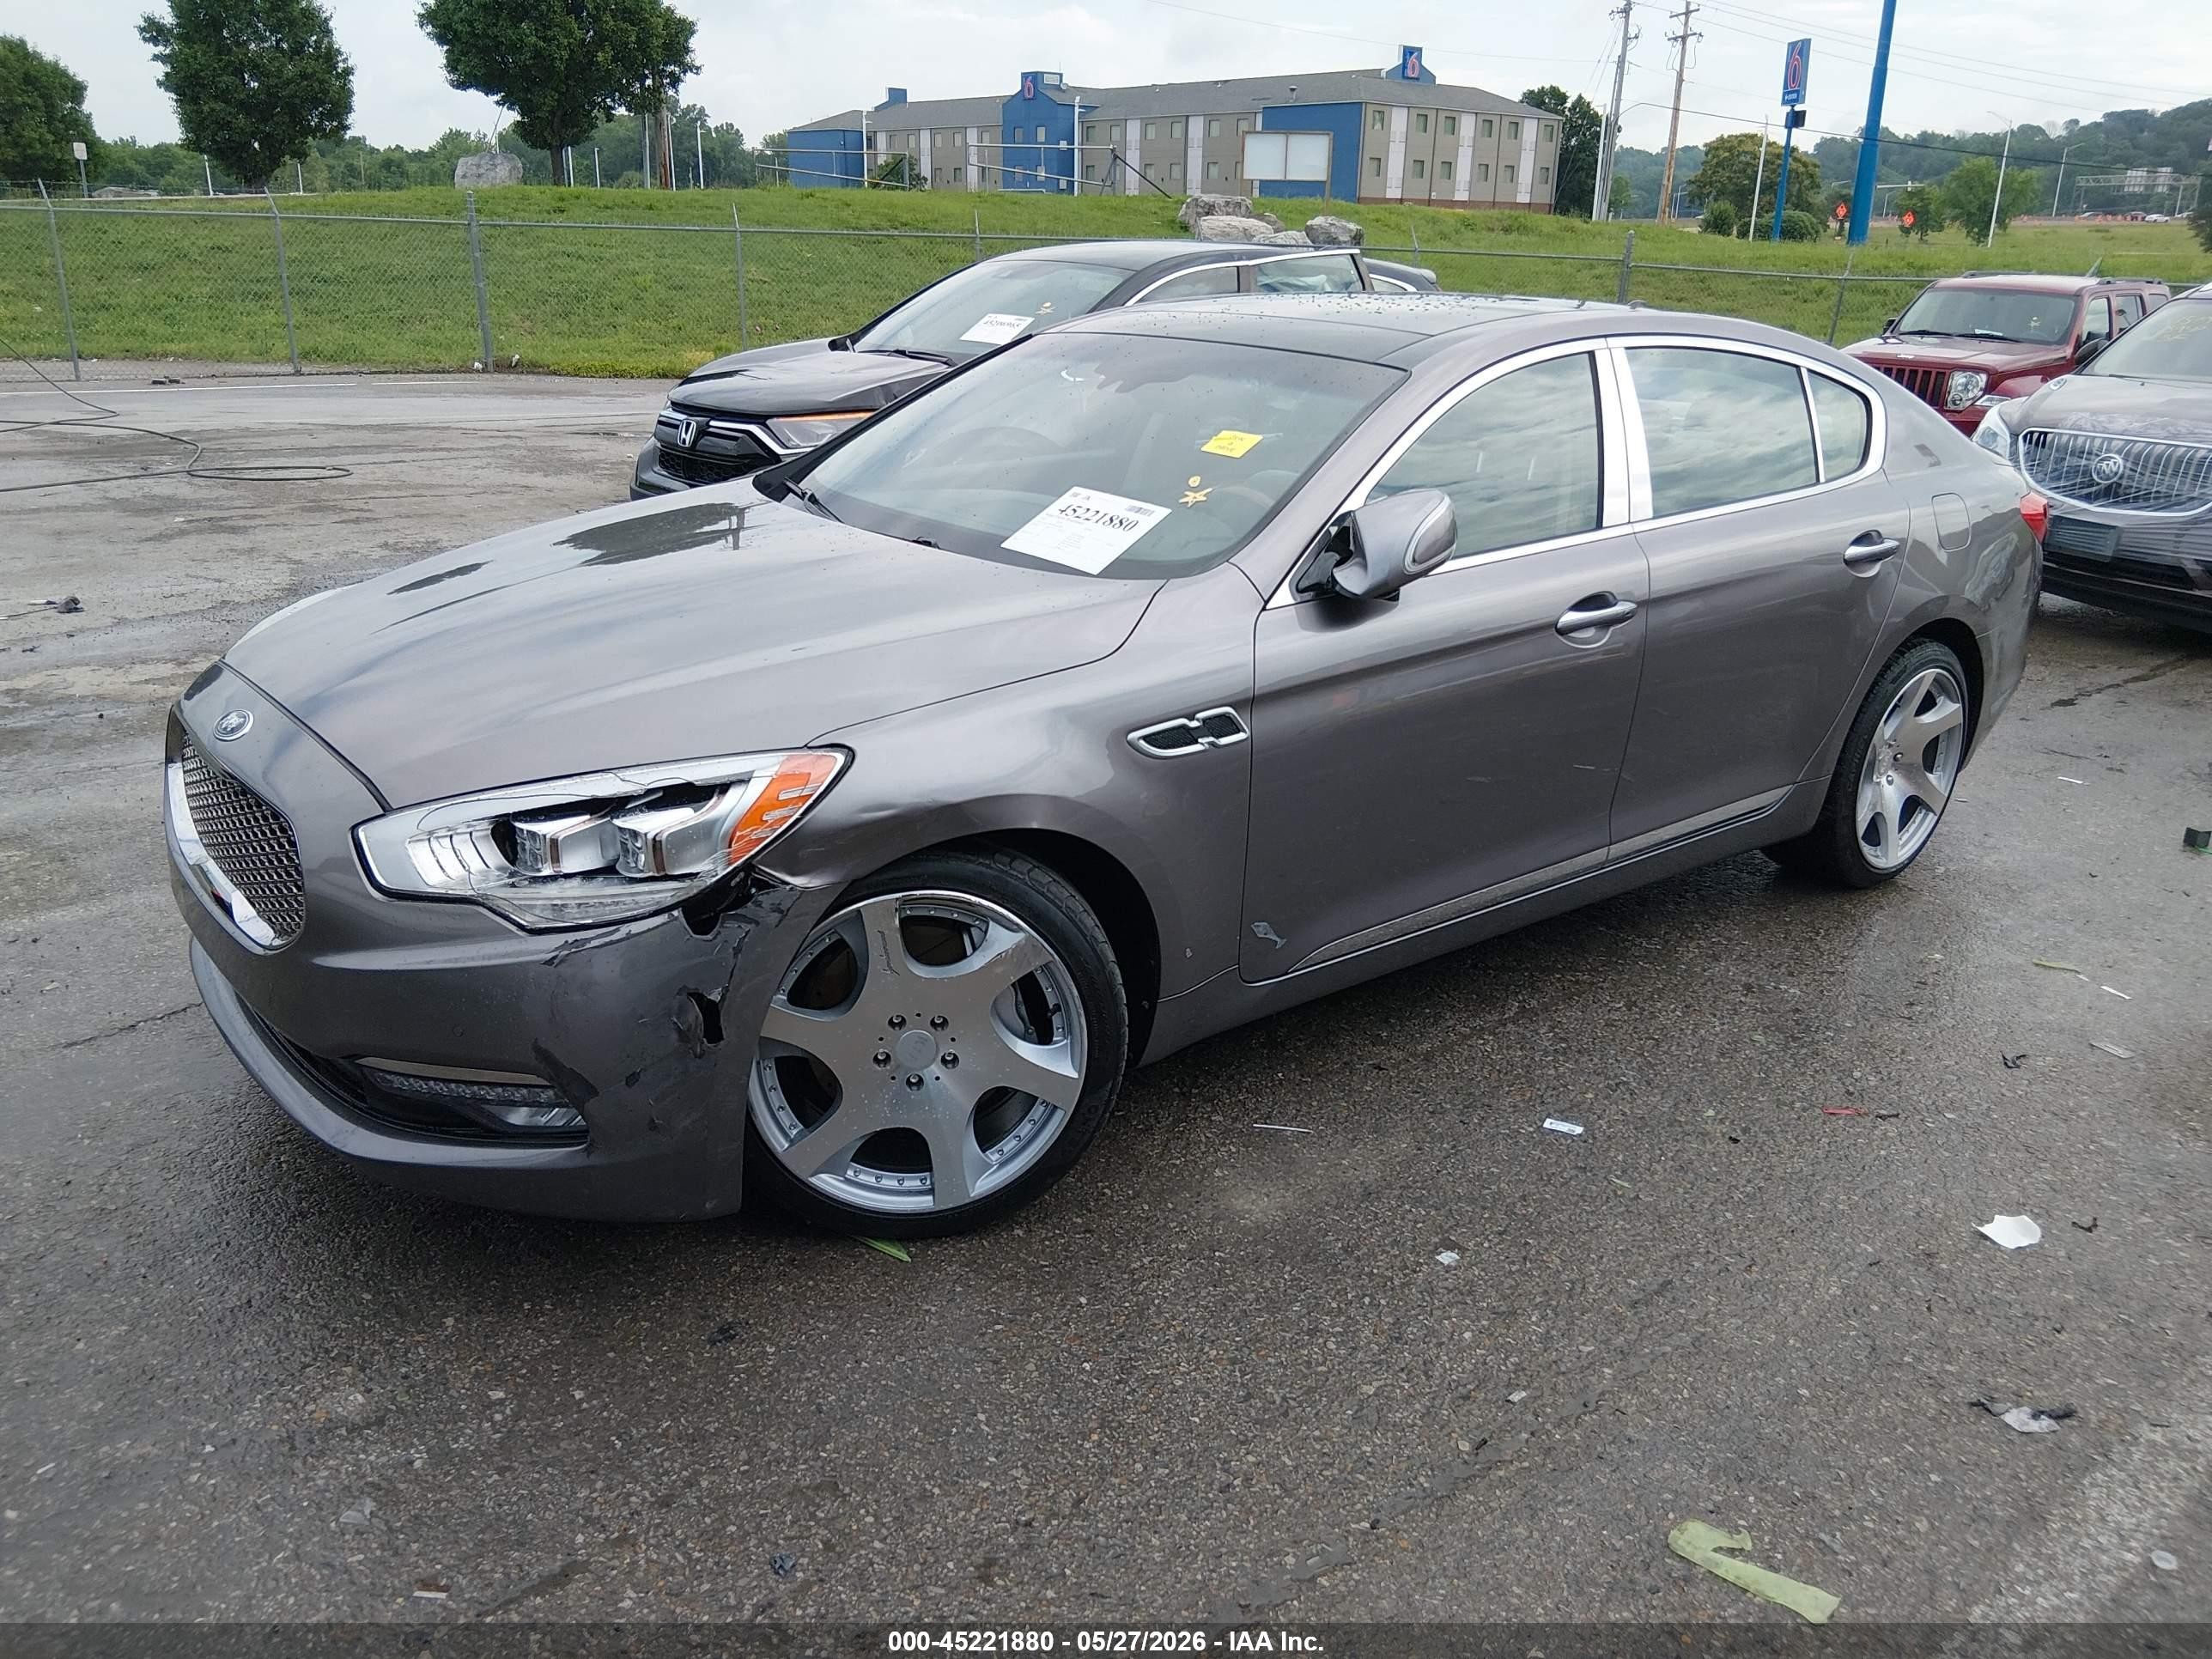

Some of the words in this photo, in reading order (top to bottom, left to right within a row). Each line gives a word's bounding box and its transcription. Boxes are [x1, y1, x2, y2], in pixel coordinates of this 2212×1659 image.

[1407, 52, 1419, 78] 6
[1787, 41, 1802, 90] 6
[1024, 76, 1034, 100] 6
[1058, 504, 1139, 532] 45221880
